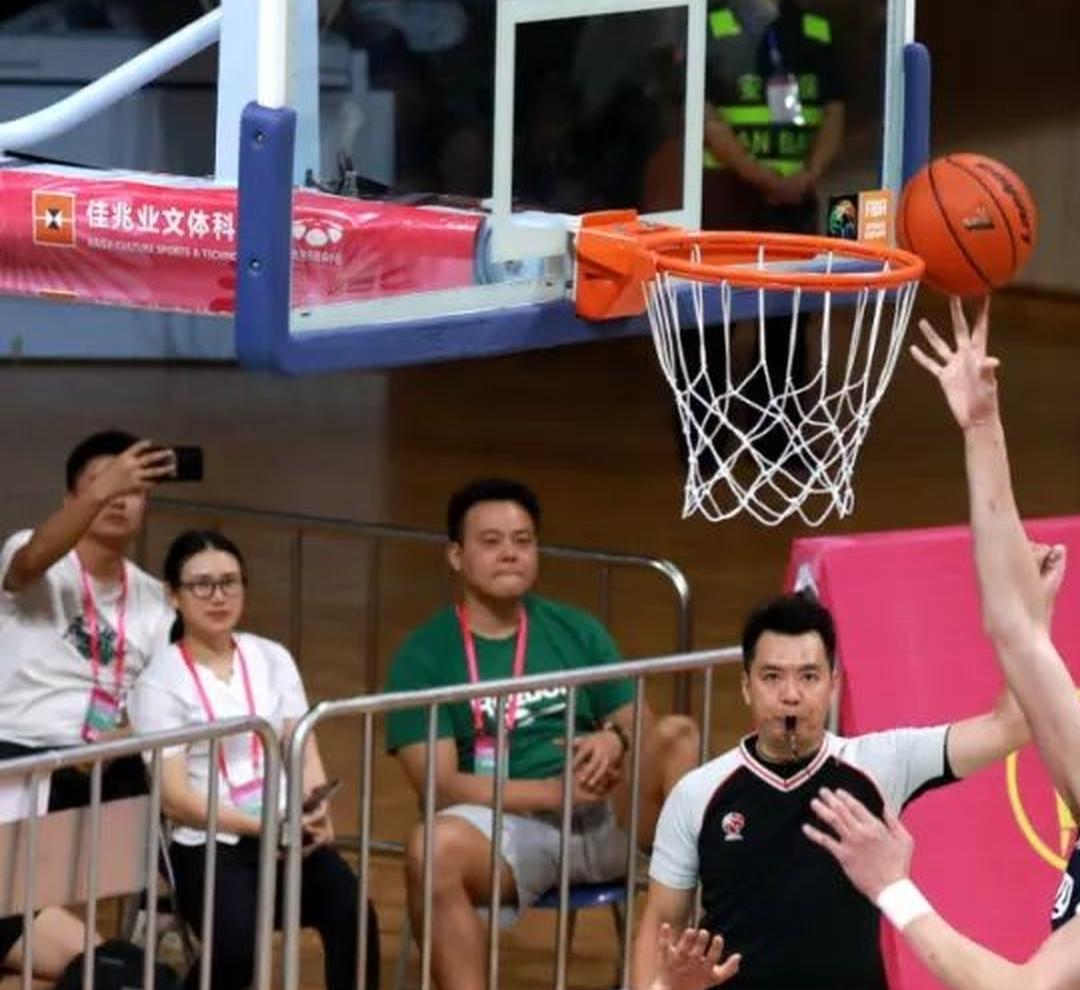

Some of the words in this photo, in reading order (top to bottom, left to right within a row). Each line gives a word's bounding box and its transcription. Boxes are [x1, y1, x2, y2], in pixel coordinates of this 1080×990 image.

[86, 199, 236, 242] 佳兆业文体科
